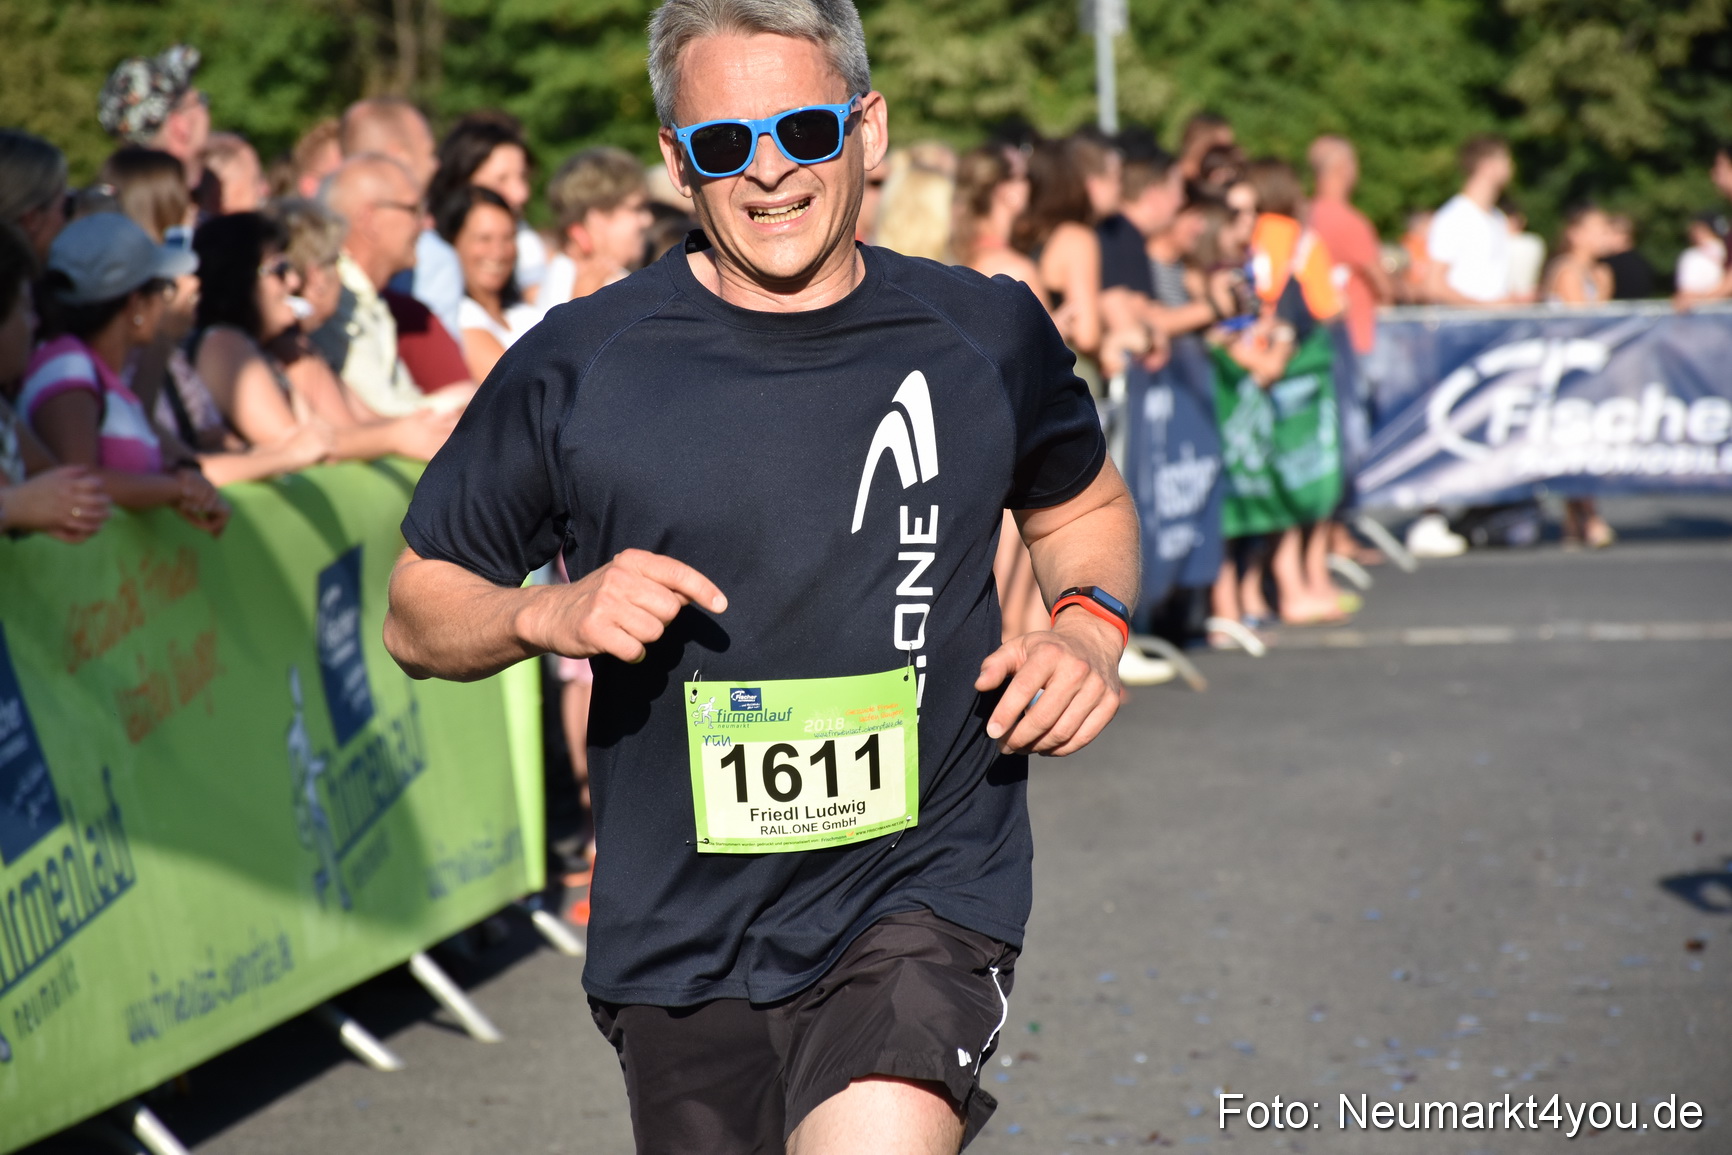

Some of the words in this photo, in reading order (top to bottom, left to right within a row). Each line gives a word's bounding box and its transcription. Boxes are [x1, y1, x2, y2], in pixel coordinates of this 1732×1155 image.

[1486, 382, 1732, 446] Fische
[894, 504, 940, 709] .ONE
[717, 707, 793, 723] firmenlauf
[804, 716, 845, 733] 2018
[720, 733, 881, 803] 1611
[750, 806, 799, 822] Friedl
[805, 799, 866, 819] Ludwig
[760, 822, 819, 836] RAIL.ONE
[822, 816, 857, 831] GmbH
